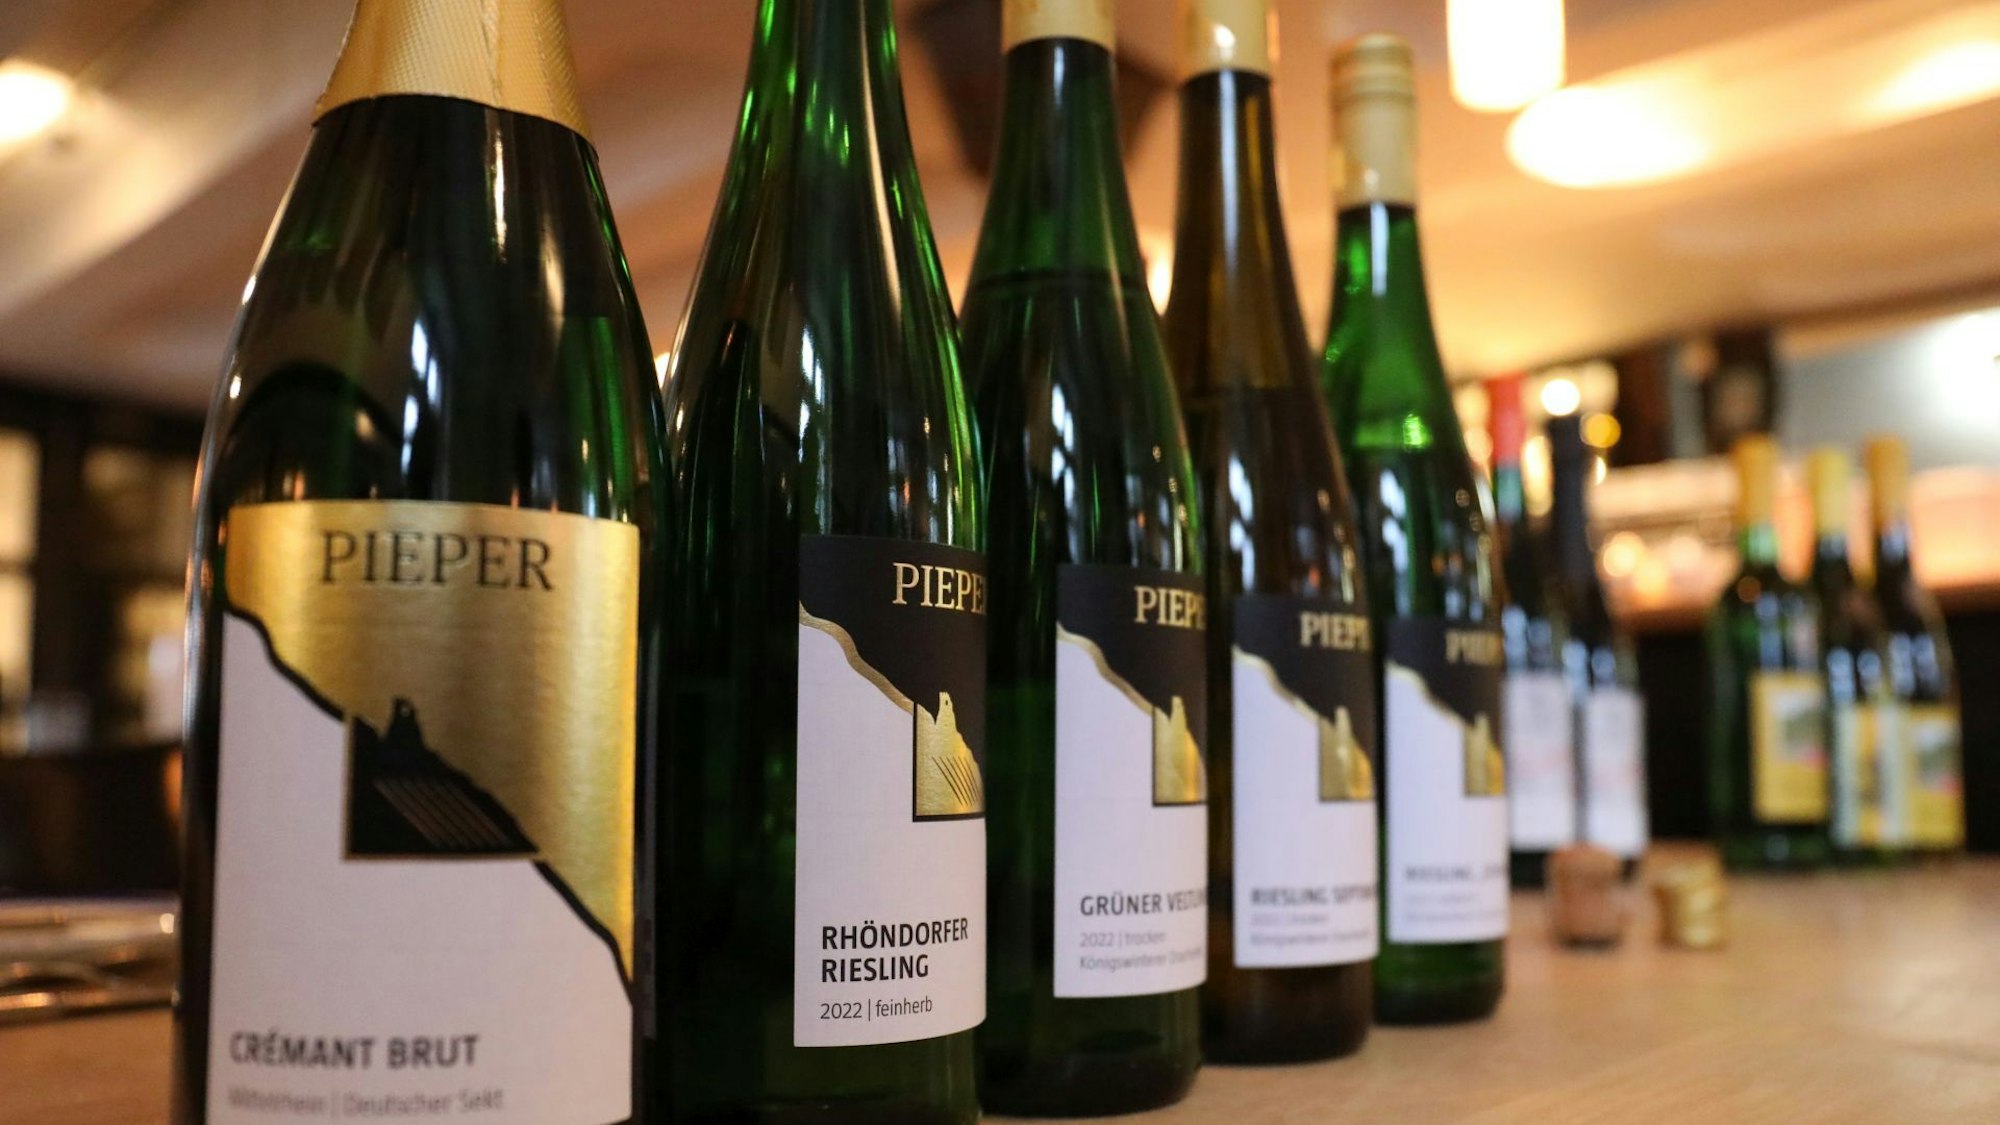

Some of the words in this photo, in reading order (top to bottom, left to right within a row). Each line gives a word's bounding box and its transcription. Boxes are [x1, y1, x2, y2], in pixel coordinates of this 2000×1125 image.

[319, 529, 553, 592] PIEPER
[1080, 890, 1162, 916] GRÜNER
[822, 917, 969, 950] RHÖNDORFER
[1079, 931, 1116, 948] 2022
[1126, 930, 1166, 945] trocken
[821, 953, 929, 983] RIESLING
[820, 1002, 863, 1020] 2022
[875, 995, 933, 1018] feinherb
[229, 1030, 377, 1069] CRÉMANT
[387, 1034, 479, 1069] BRUT
